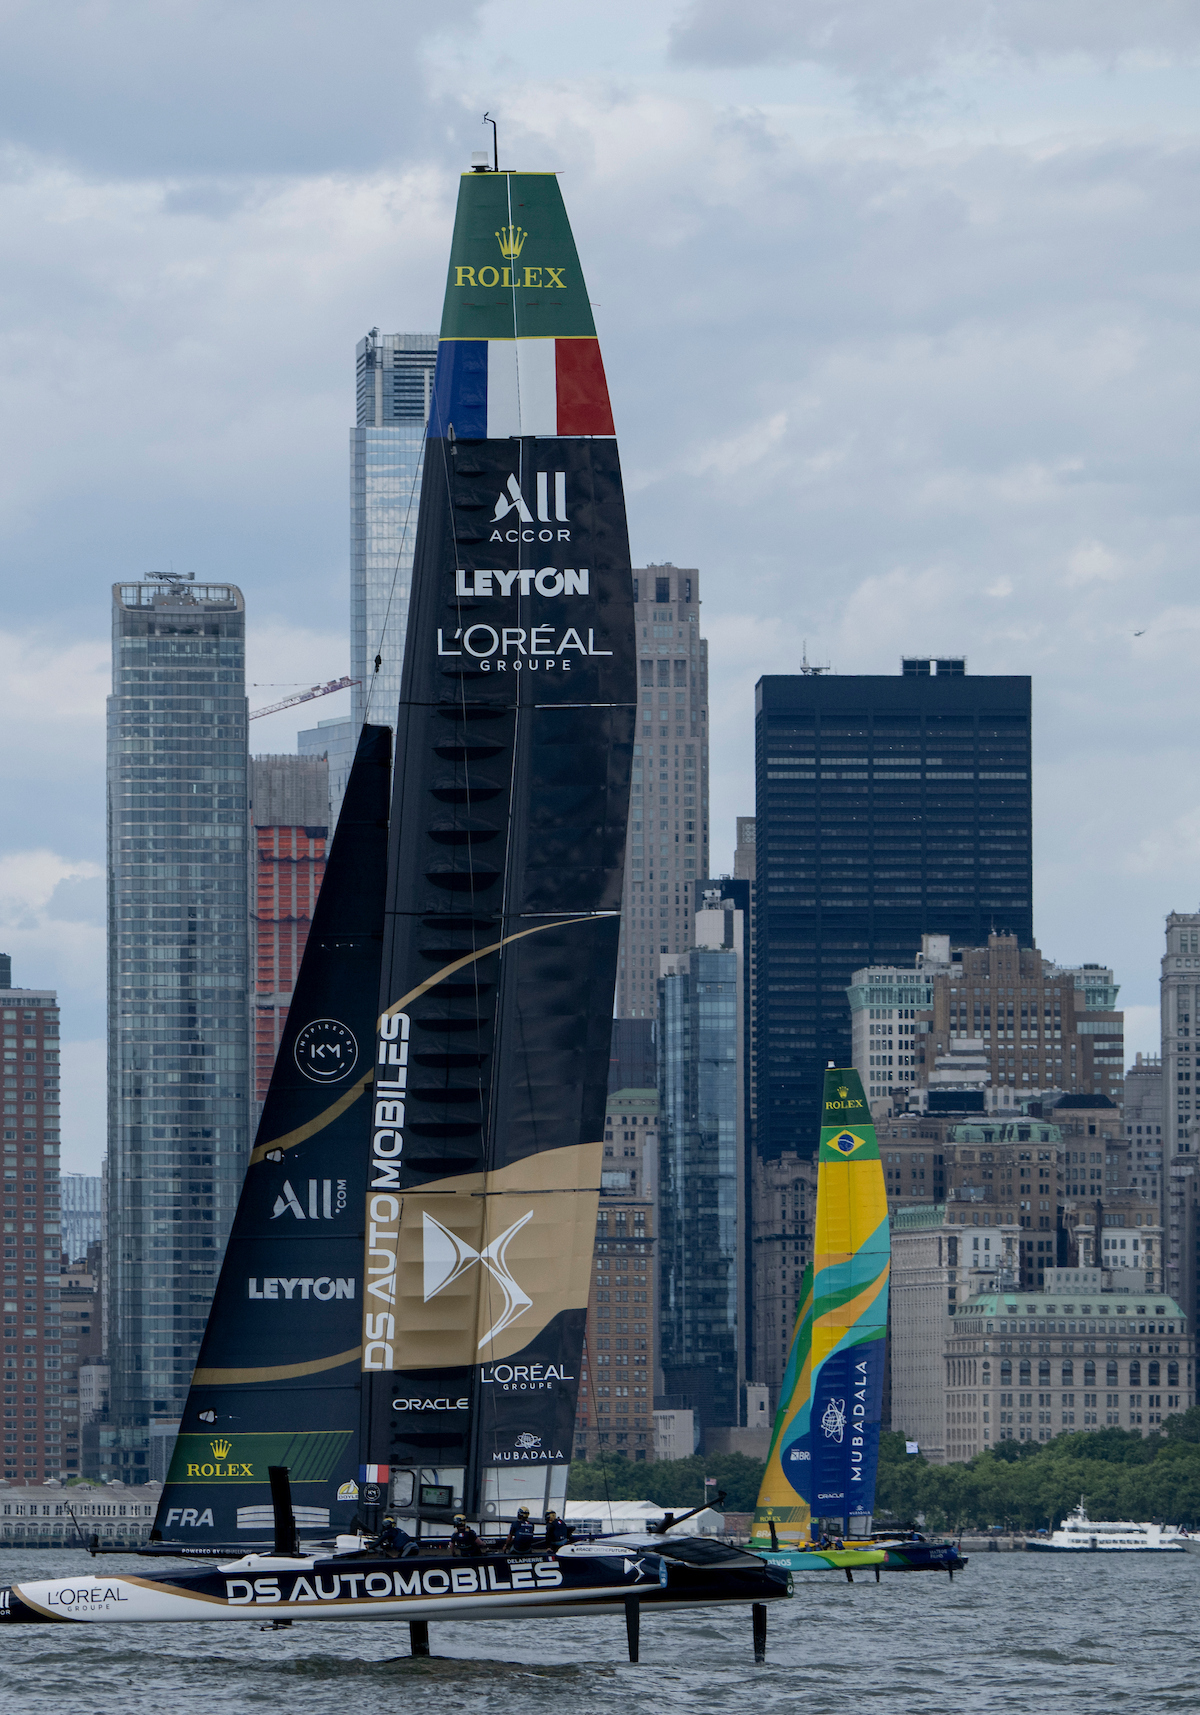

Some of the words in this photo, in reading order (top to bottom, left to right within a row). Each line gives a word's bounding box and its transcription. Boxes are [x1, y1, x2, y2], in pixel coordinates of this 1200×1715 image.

[454, 265, 567, 288] ROLEX
[489, 529, 571, 542] ACCOR
[456, 567, 589, 597] LEYTON
[437, 623, 613, 658] L'ORÉAL
[480, 660, 571, 671] GROUPE
[299, 1023, 345, 1053] INSPIRED
[346, 1040, 353, 1053] BY
[311, 1044, 340, 1058] KM
[825, 1099, 863, 1109] ROLEX
[367, 1012, 410, 1305] AUTOMOBILES
[249, 1277, 355, 1300] LEYTON
[364, 1312, 395, 1369] DS
[481, 1363, 574, 1383] L'ORÉAL
[503, 1382, 552, 1391] GROUPE
[392, 1398, 469, 1410] ORACLE
[851, 1361, 867, 1481] MUBADALA
[492, 1450, 563, 1460] MUBADALA
[187, 1463, 254, 1476] ROLEX
[165, 1508, 214, 1527] FRA
[226, 1578, 282, 1604] DS
[289, 1561, 563, 1601] AUTOMOBILES
[48, 1587, 128, 1605] L'ORÉAL
[67, 1604, 110, 1612] GROUPE
